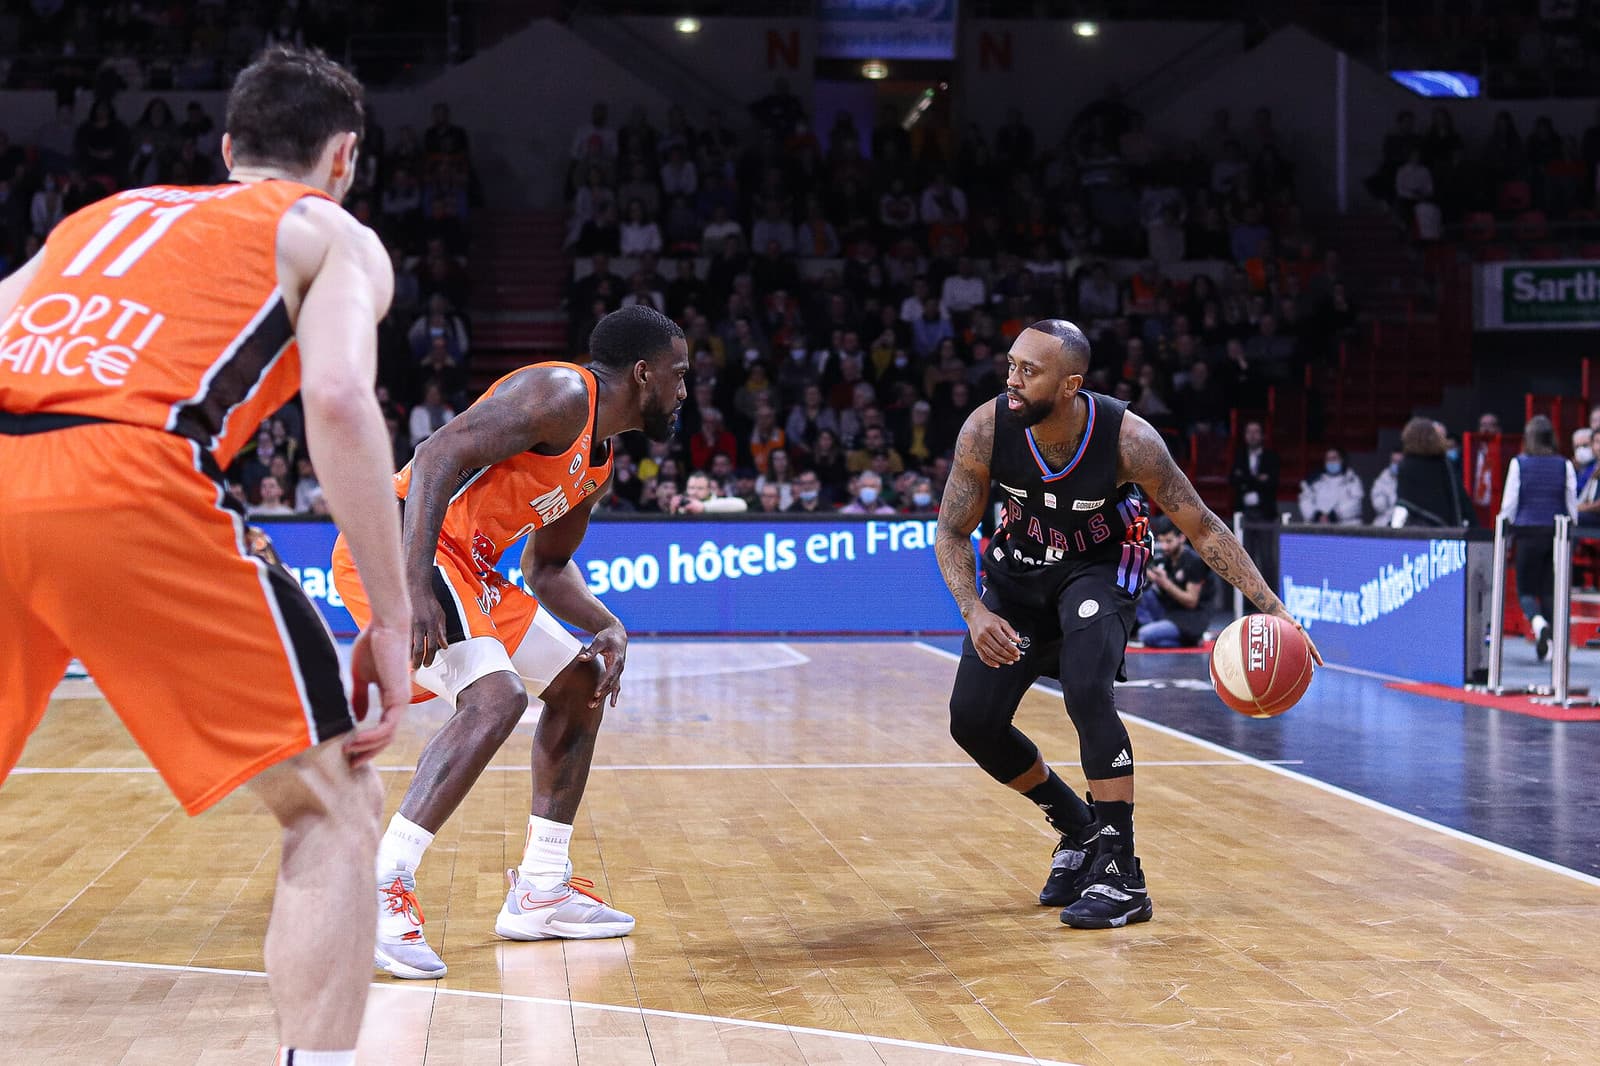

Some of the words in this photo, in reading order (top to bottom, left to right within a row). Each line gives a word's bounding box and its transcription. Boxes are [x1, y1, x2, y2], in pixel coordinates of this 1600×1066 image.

[767, 30, 799, 69] N
[979, 31, 1013, 71] N
[62, 200, 196, 277] 11
[1008, 498, 1111, 552] PARIS
[587, 554, 660, 595] 300
[669, 533, 796, 584] hôtels
[806, 531, 856, 563] en
